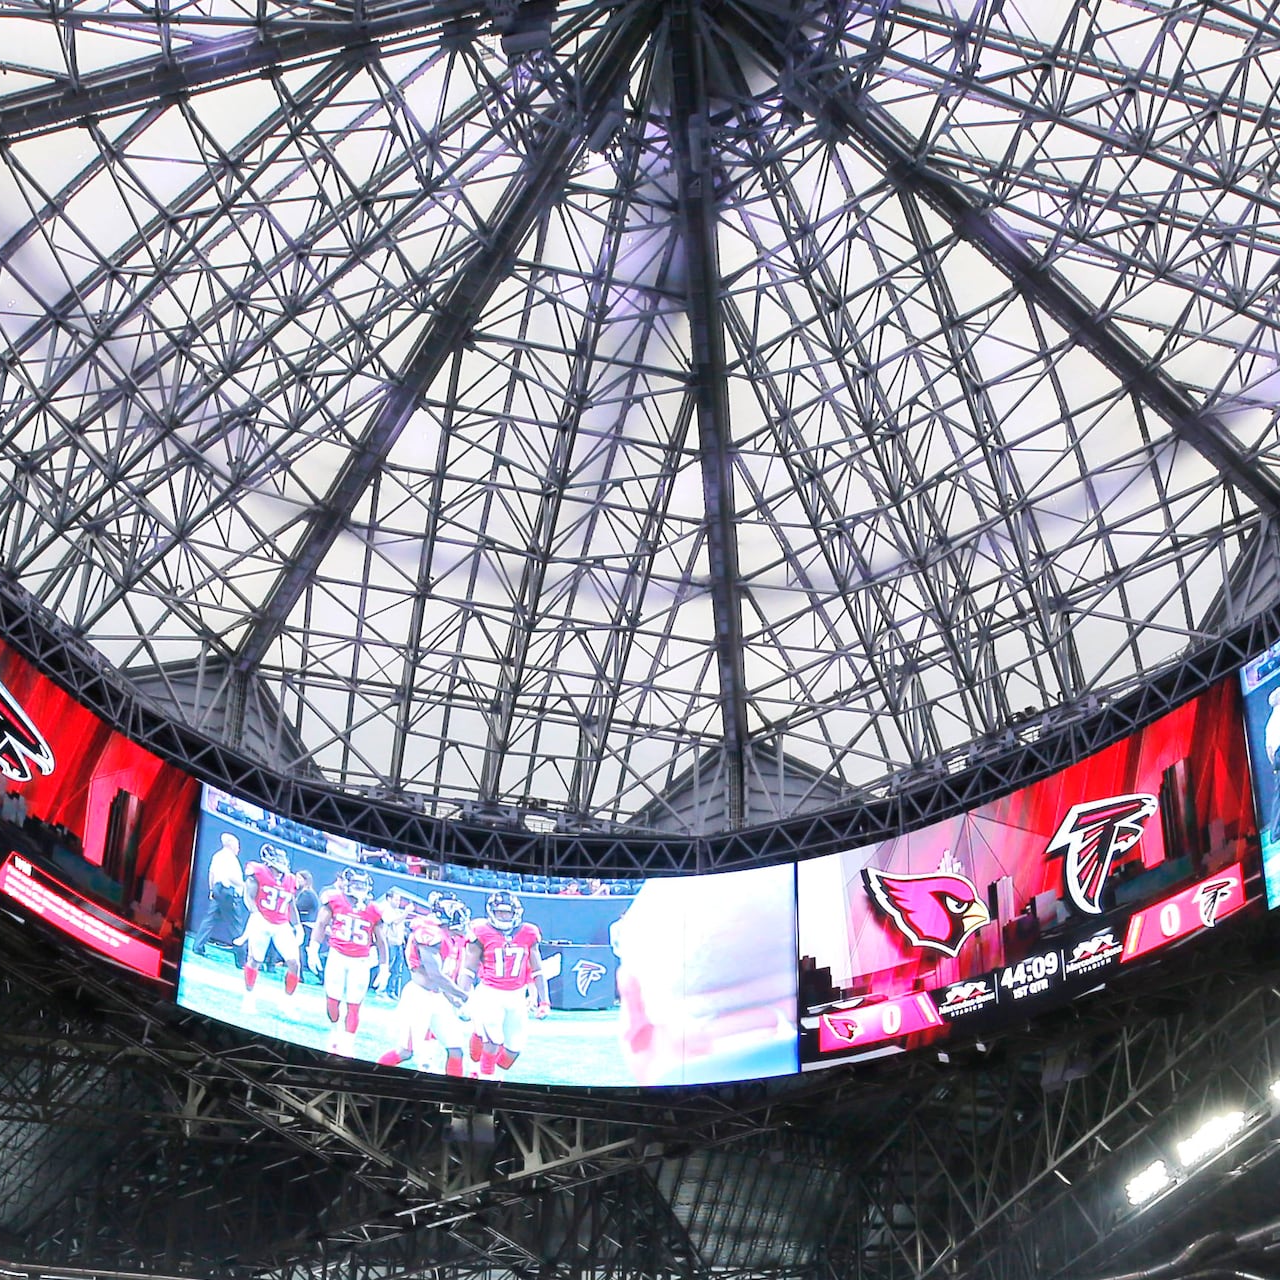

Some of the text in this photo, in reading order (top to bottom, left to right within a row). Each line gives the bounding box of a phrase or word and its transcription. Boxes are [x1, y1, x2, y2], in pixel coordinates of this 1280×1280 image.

[260, 886, 294, 914] 37
[333, 918, 372, 945] 35
[1160, 903, 1181, 937] 0
[494, 946, 525, 977] 17
[1001, 952, 1059, 990] 44:09
[1012, 980, 1049, 1000] 1ST QTR
[882, 1005, 901, 1035] 0
